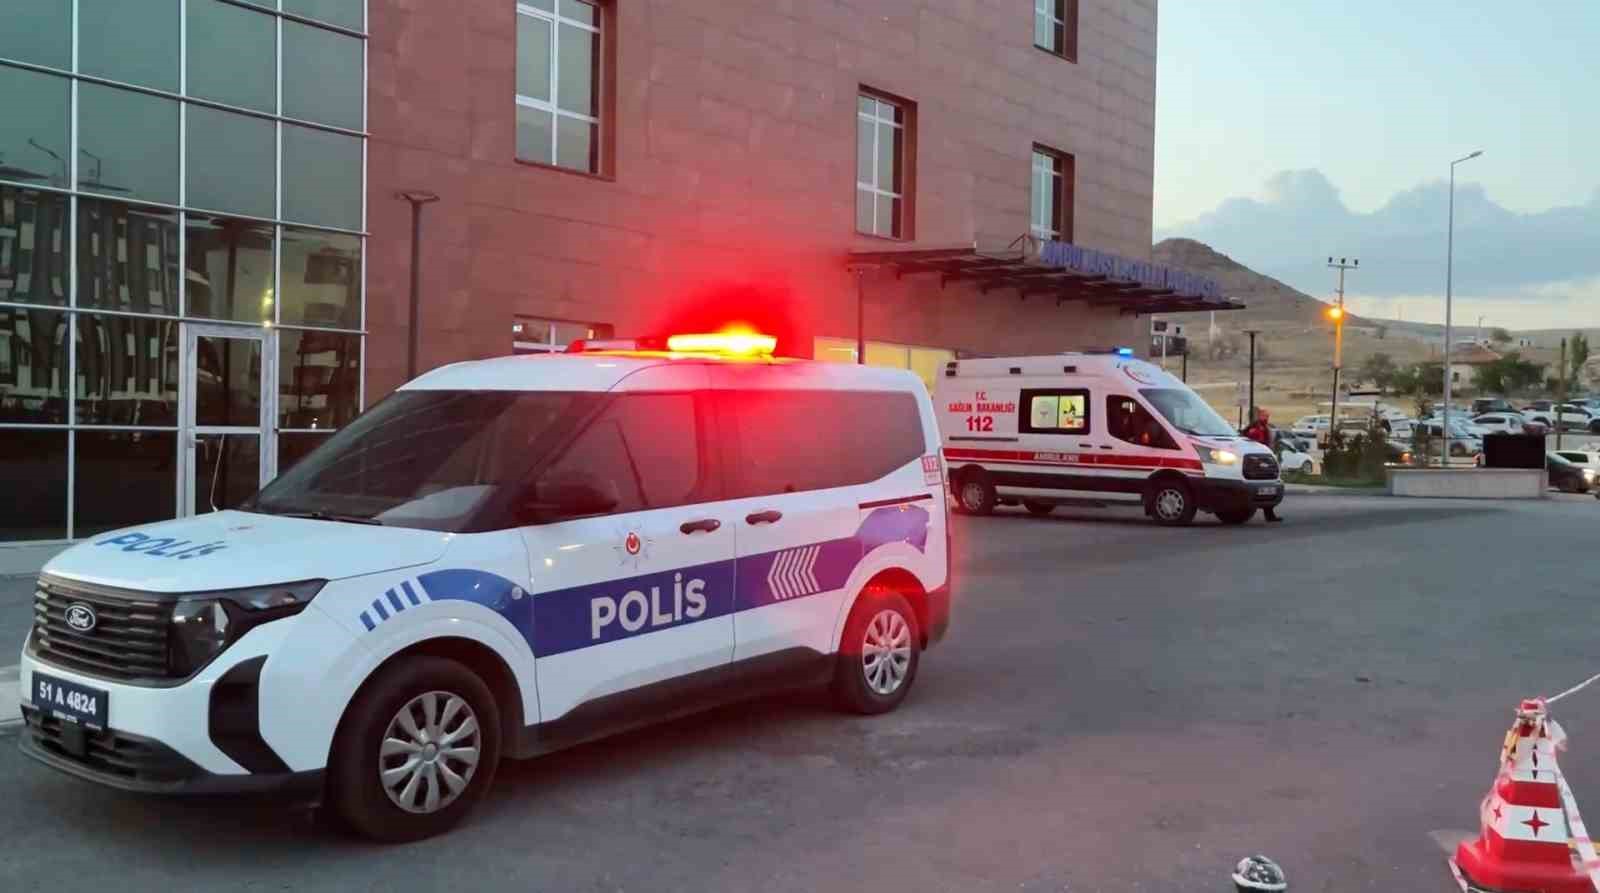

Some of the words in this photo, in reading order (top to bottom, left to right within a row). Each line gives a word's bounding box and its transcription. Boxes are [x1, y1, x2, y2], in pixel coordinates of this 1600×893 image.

[966, 416, 993, 432] 112
[70, 608, 89, 627] Ford
[591, 573, 707, 640] POLİS
[39, 680, 52, 702] 51
[55, 686, 64, 706] A
[66, 690, 97, 716] 4824
